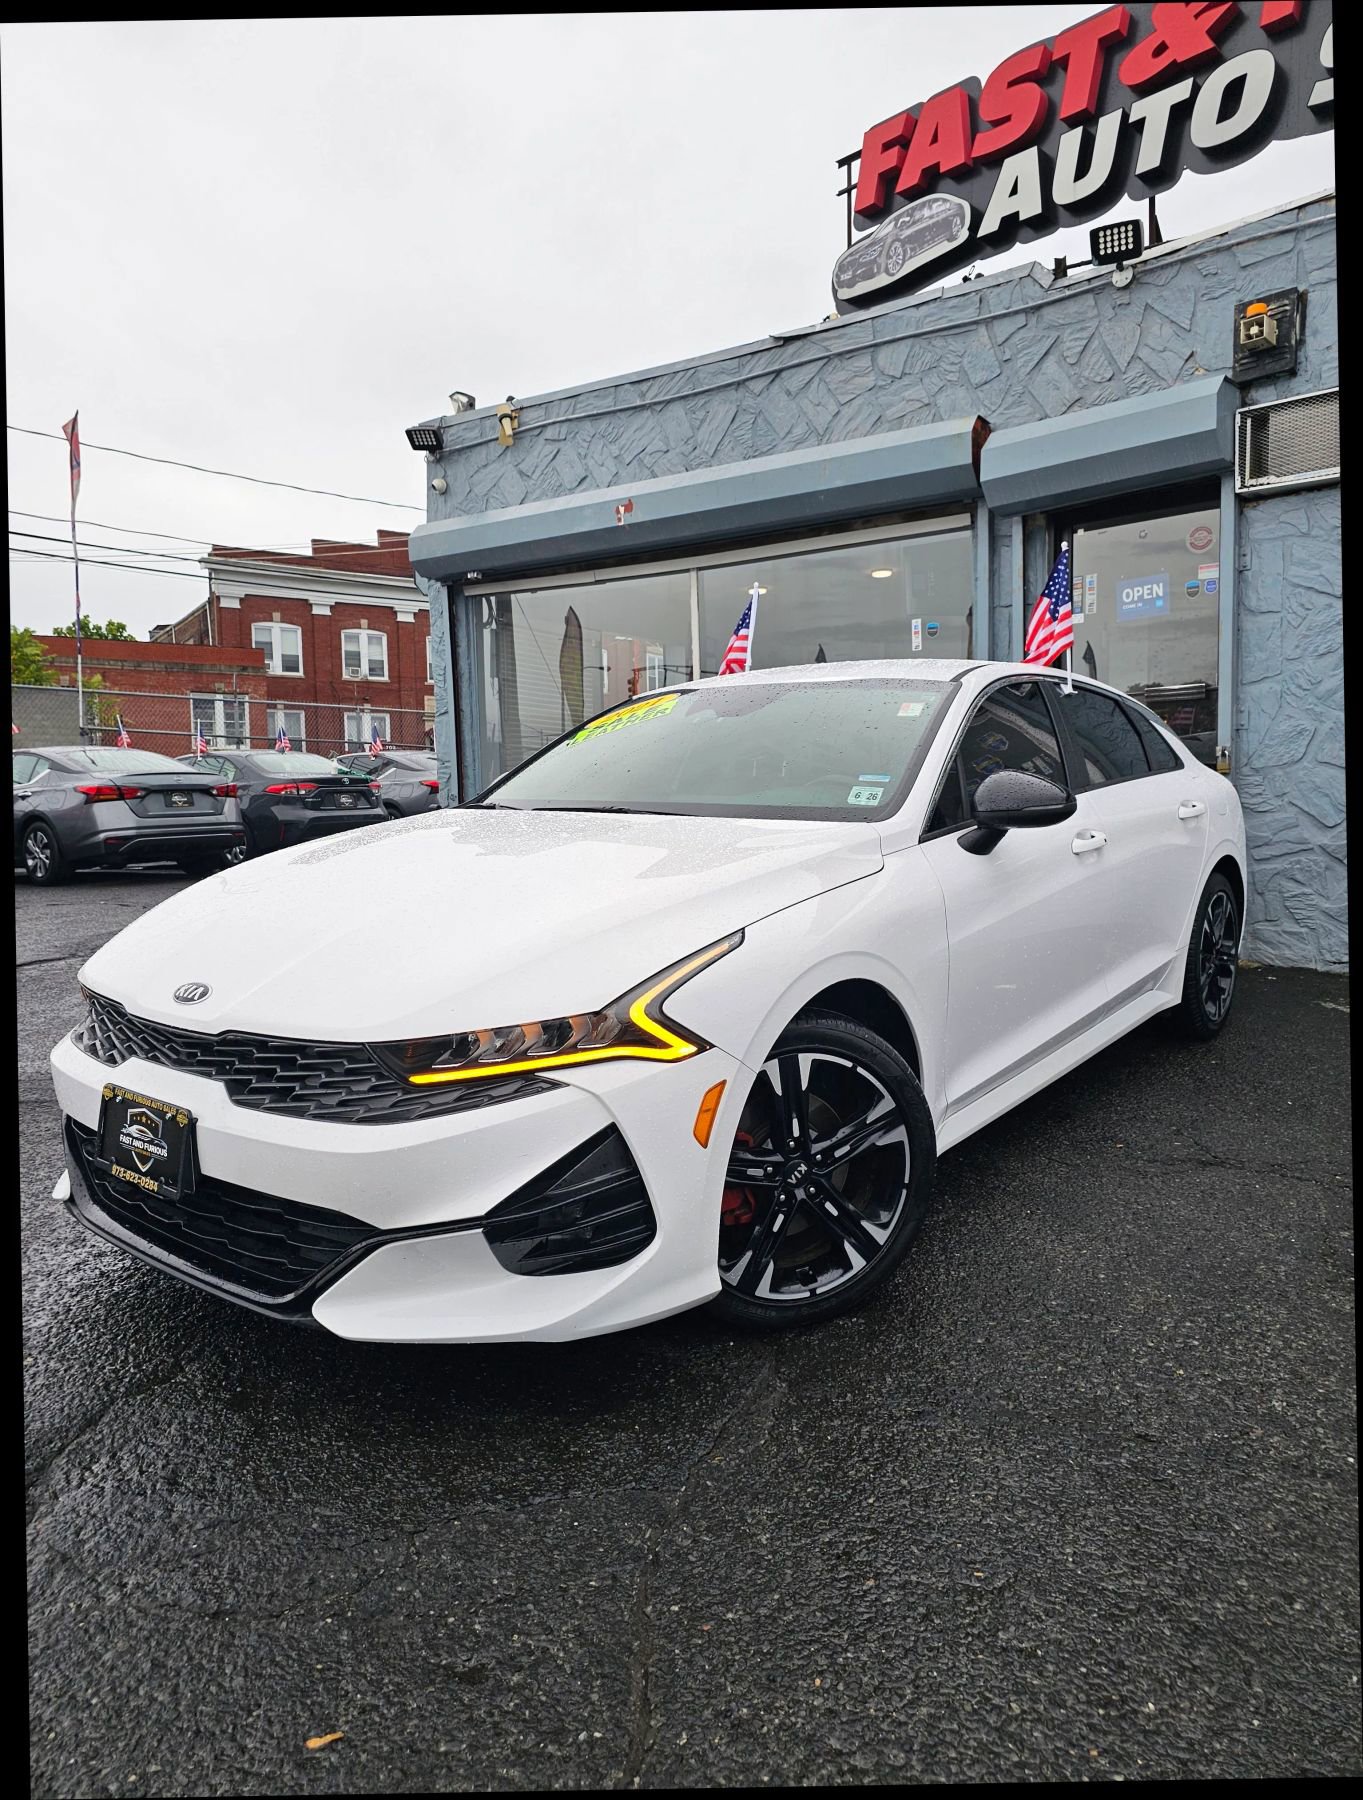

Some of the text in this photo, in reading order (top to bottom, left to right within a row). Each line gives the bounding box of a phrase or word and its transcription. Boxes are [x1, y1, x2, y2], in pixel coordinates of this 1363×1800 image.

[855, 4, 1131, 215] FAST
[977, 49, 1276, 238] AUTO
[1122, 582, 1164, 603] OPEN
[125, 1091, 134, 1101] AND
[151, 1100, 163, 1111] AUTO
[163, 1104, 177, 1116] SALES
[120, 1134, 132, 1146] FAST
[132, 1139, 144, 1149] AND
[144, 1142, 168, 1157] FURIOUS
[787, 1163, 808, 1184] KIA
